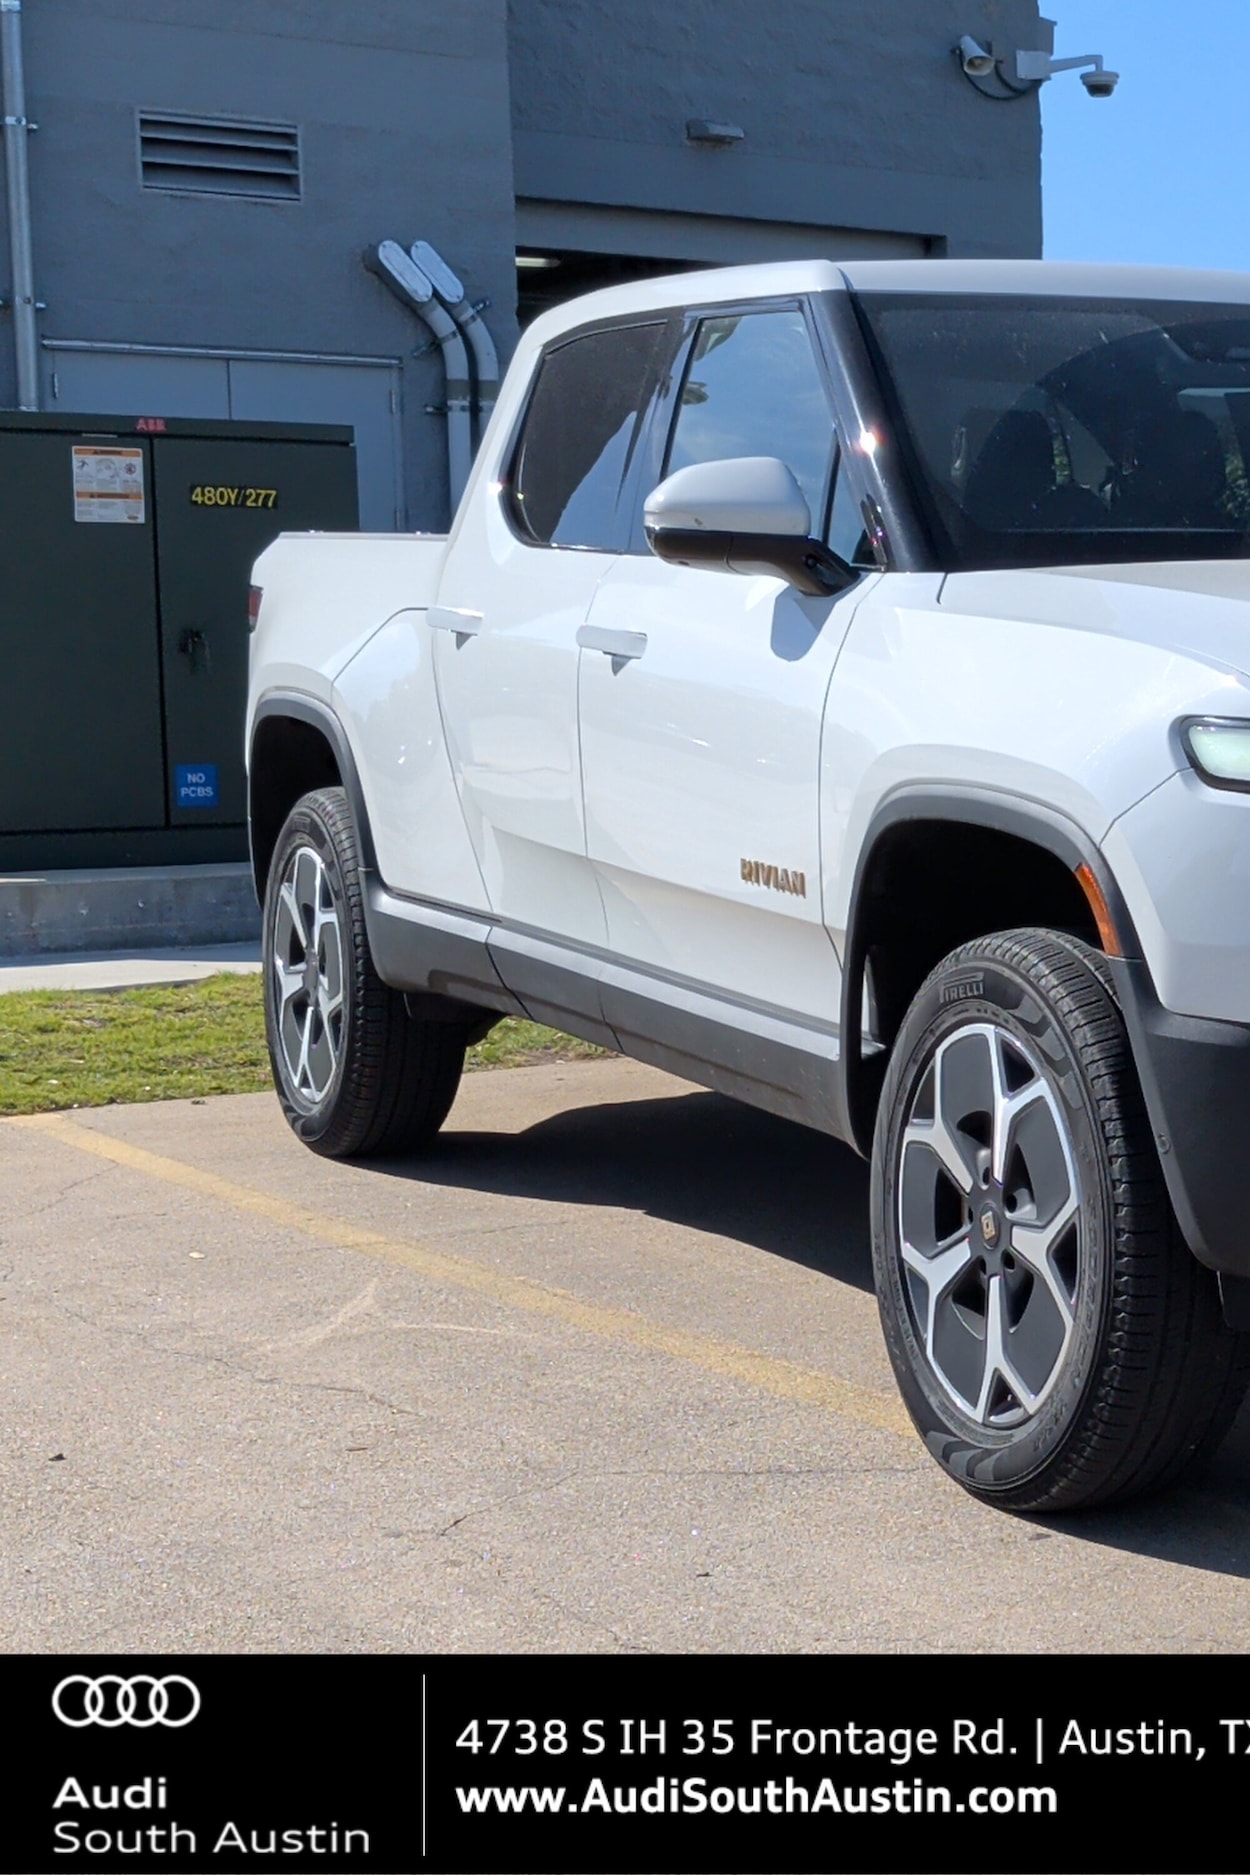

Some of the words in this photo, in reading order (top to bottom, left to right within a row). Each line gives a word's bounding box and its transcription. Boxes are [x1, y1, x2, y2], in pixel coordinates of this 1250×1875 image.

[136, 417, 167, 432] ABB
[191, 486, 277, 508] 480Y/277
[187, 772, 206, 784] NO
[180, 786, 214, 798] PCBS
[740, 857, 807, 899] RIVIAN
[939, 971, 984, 1003] PIRELLI
